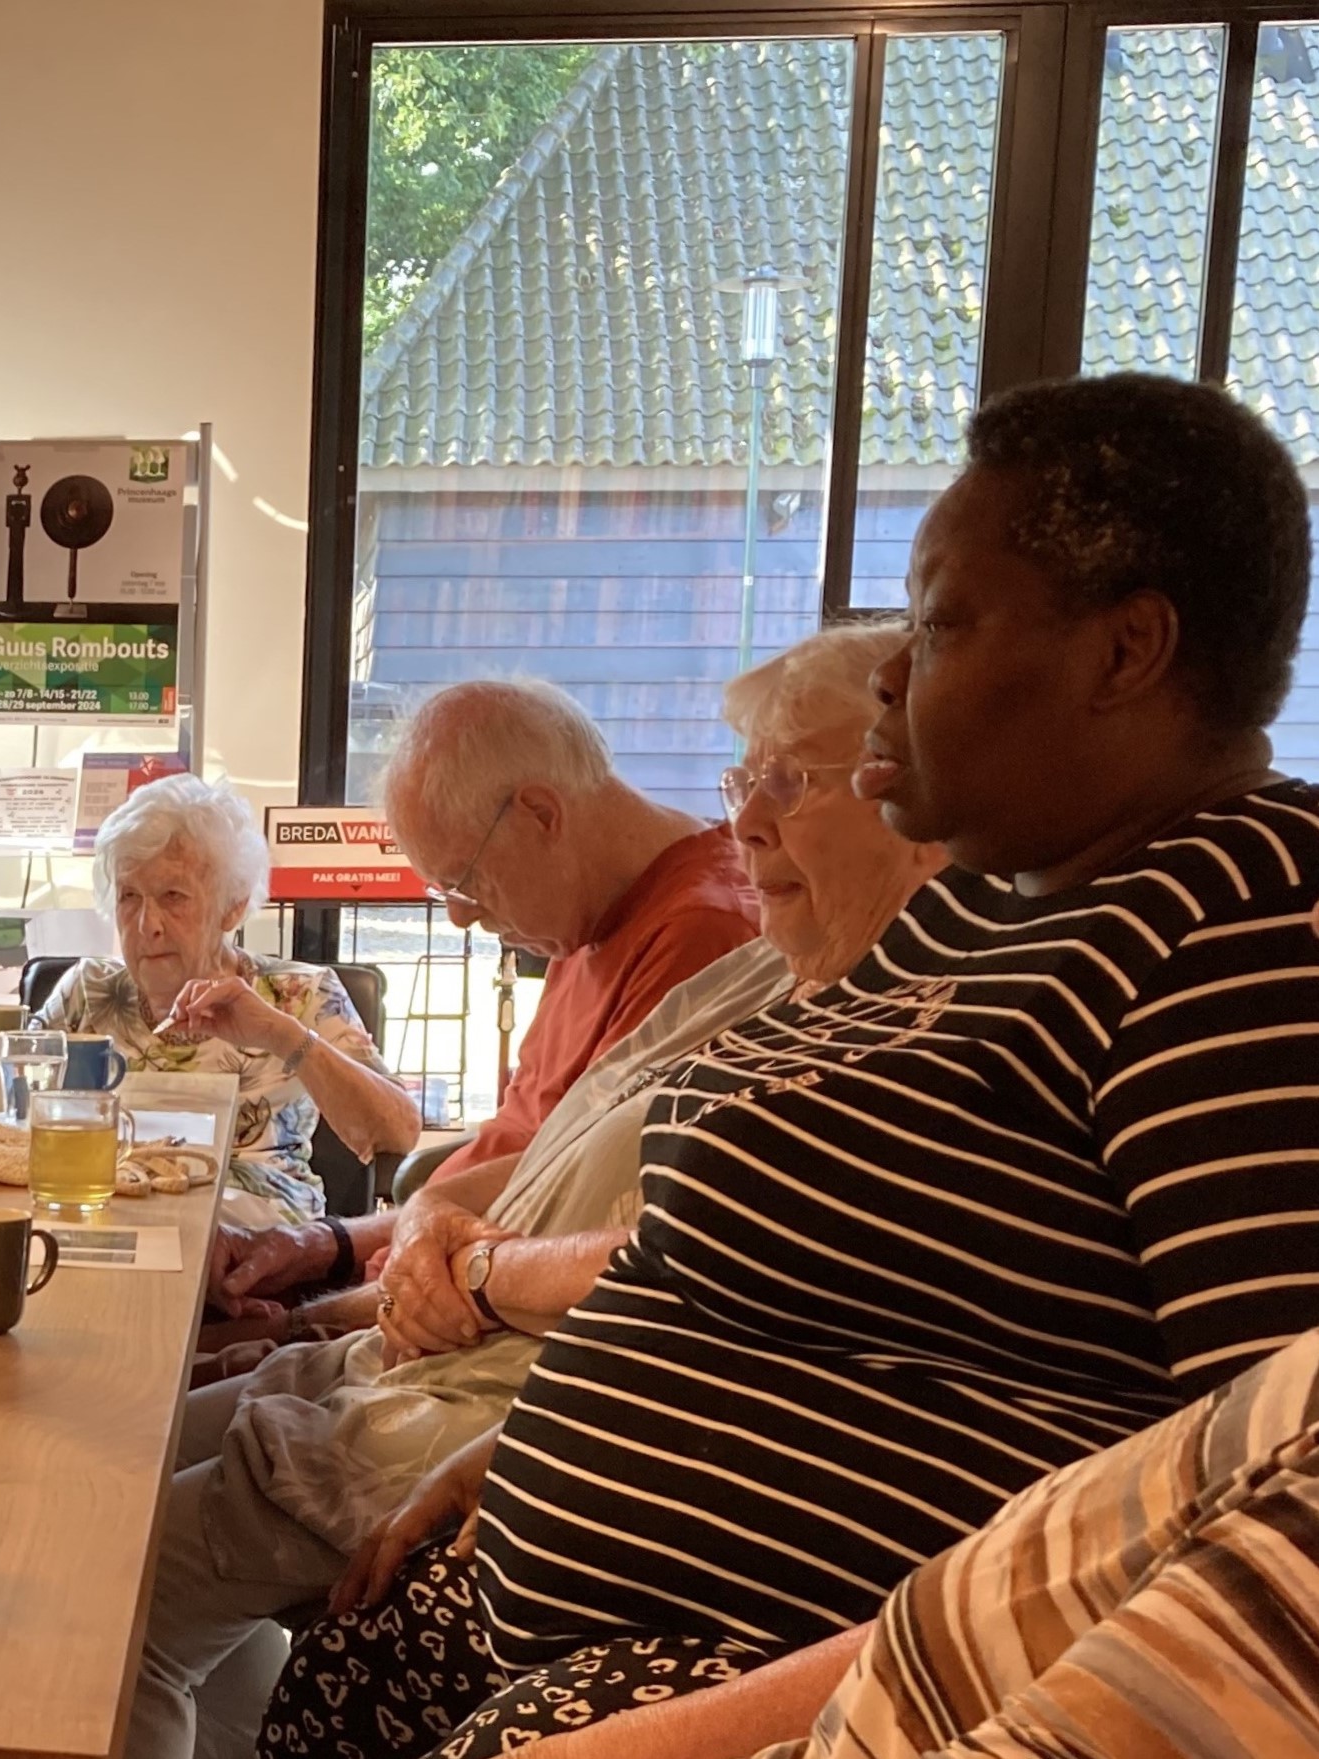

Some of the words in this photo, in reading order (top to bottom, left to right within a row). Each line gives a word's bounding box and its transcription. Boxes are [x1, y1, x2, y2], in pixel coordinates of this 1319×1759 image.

[52, 637, 169, 659] Rombouts
[16, 689, 33, 699] 7/8
[39, 689, 65, 699] 14/15
[71, 690, 97, 699] 21/22
[25, 702, 76, 712] september
[77, 701, 101, 711] 2024
[280, 826, 338, 841] BREDA
[313, 873, 334, 882] PAK
[336, 873, 374, 882] GRATIS
[376, 873, 401, 882] MEE!
